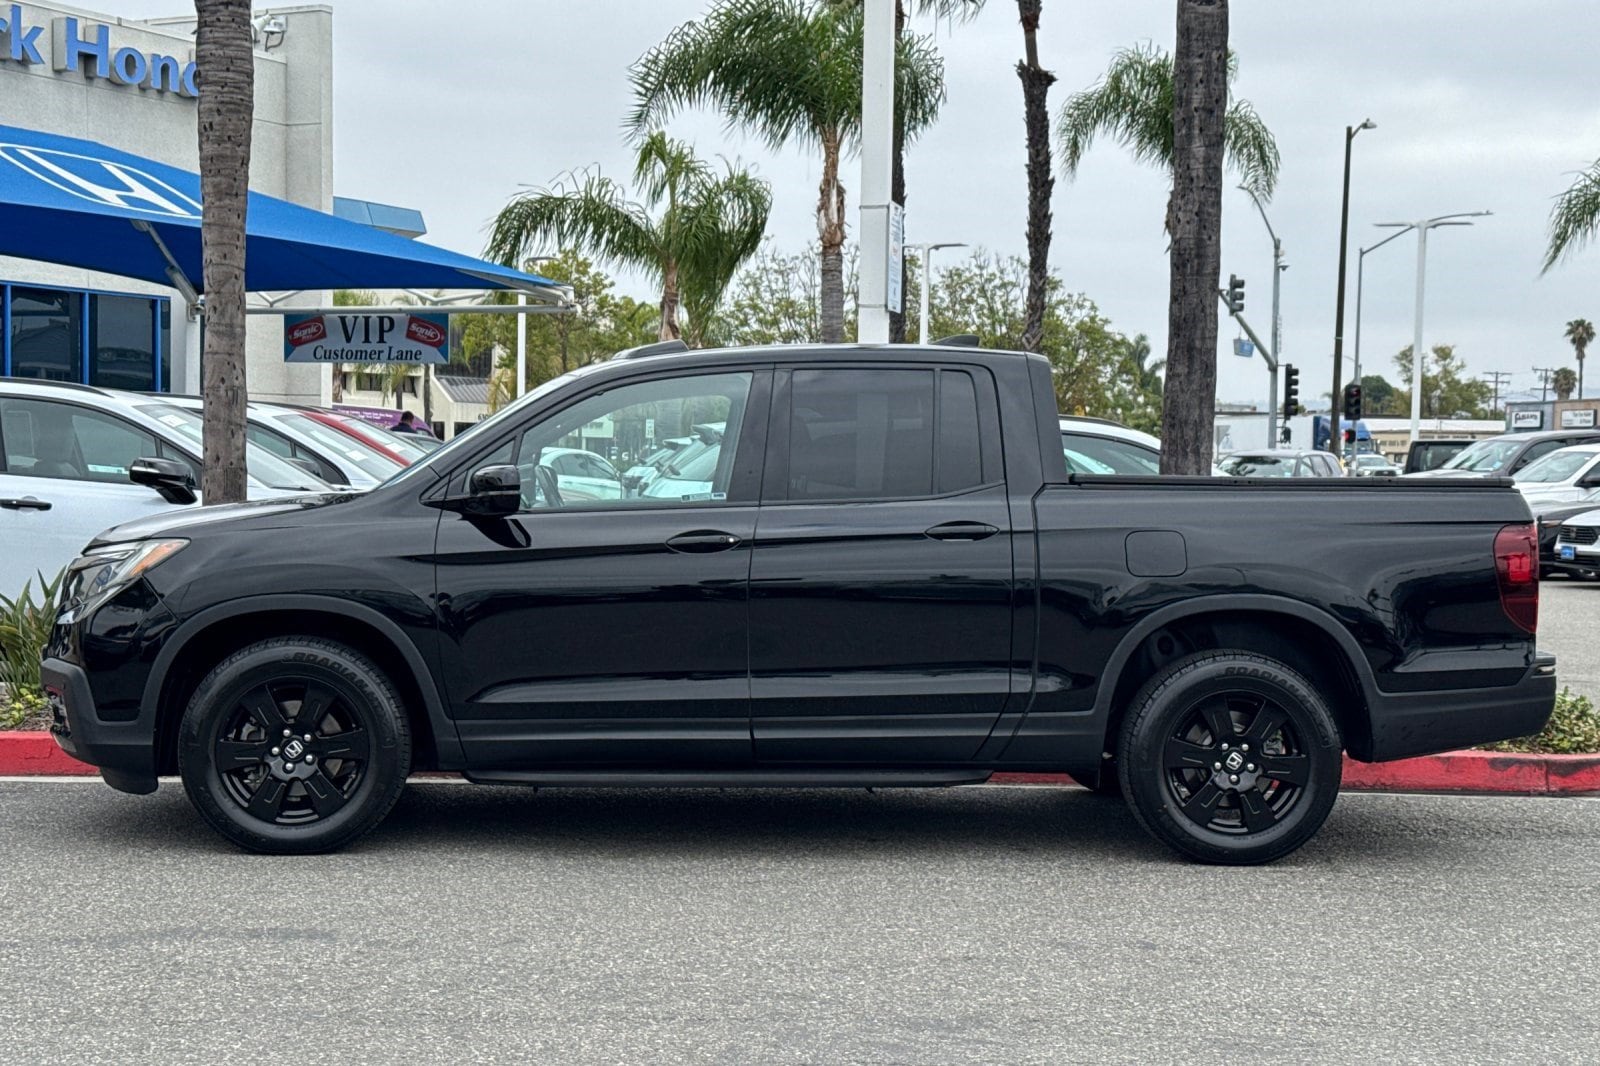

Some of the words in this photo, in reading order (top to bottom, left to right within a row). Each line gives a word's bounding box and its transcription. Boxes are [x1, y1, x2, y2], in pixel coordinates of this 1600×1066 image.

[293, 323, 321, 338] Sonic
[338, 315, 395, 344] VIP
[410, 322, 437, 338] Sonic
[313, 345, 385, 361] Customer
[387, 345, 422, 361] Lane
